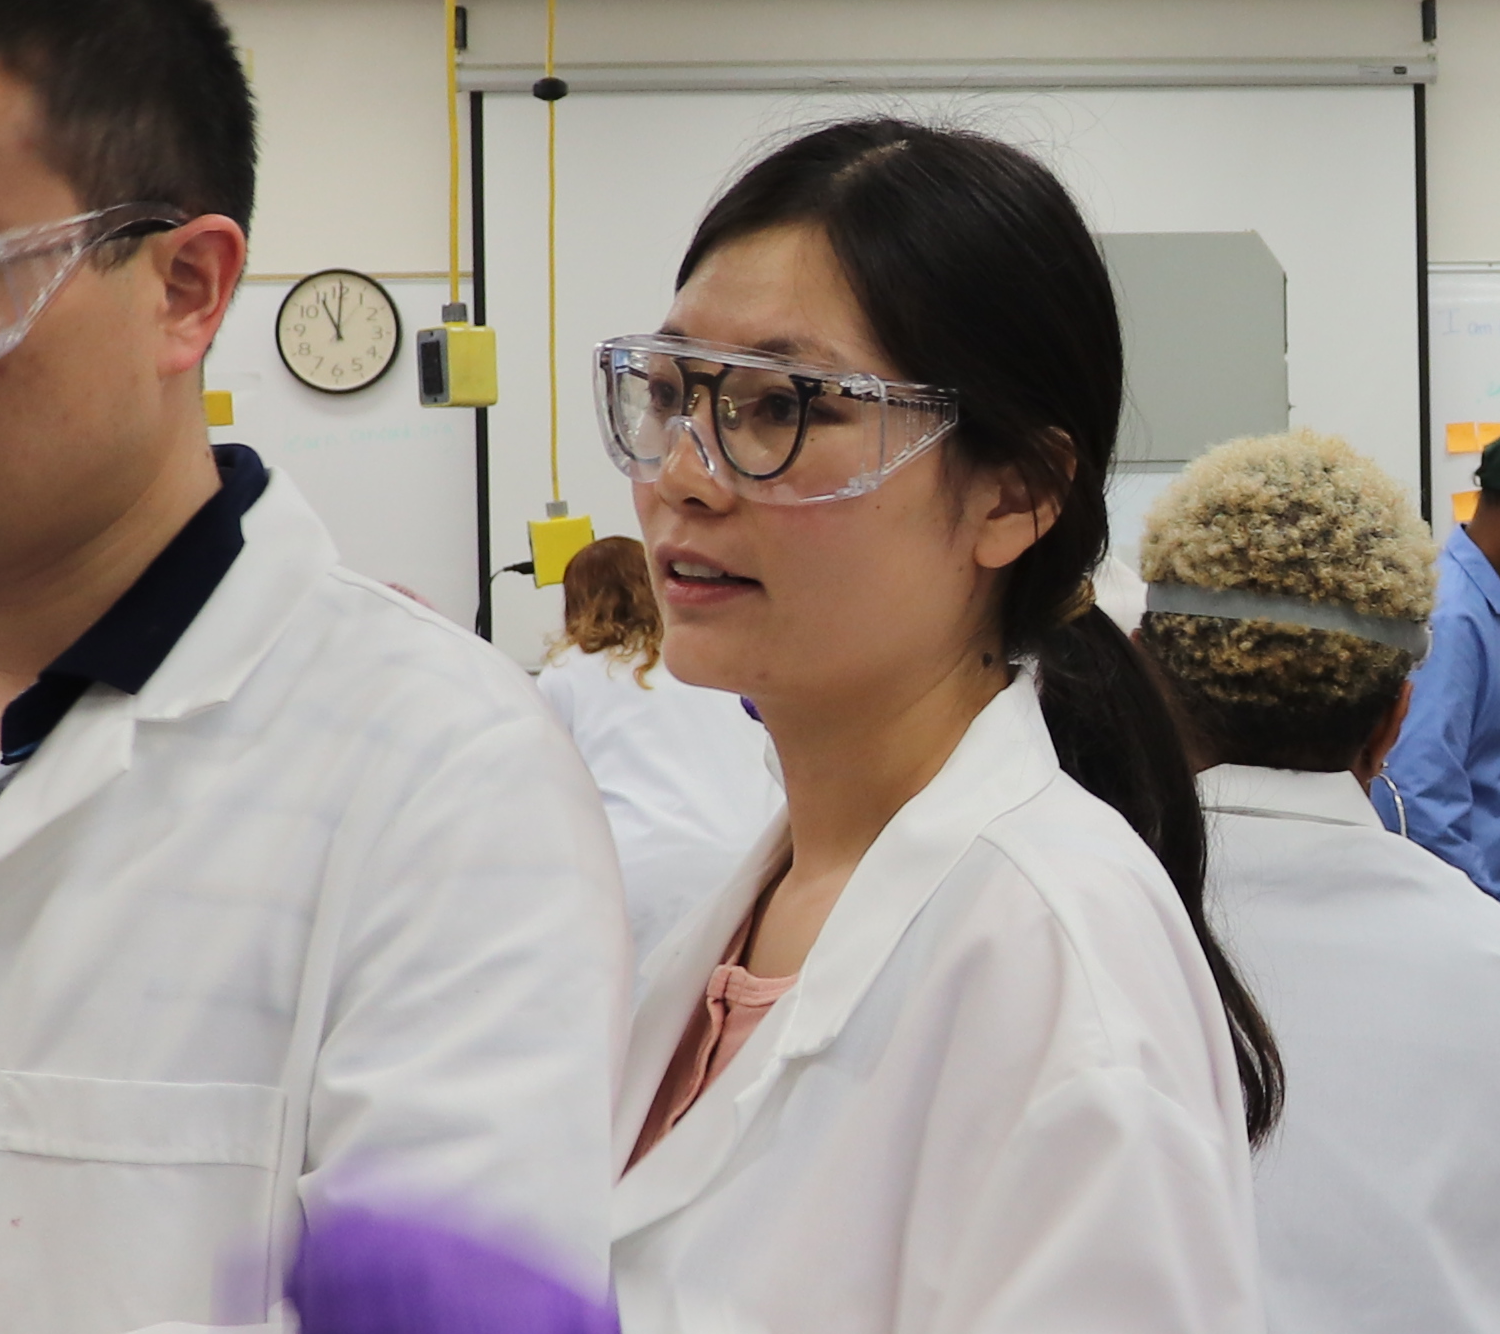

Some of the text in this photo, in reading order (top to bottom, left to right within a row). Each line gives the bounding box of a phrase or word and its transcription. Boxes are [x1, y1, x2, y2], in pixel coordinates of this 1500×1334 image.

[358, 292, 363, 306] 1
[300, 305, 319, 319] 10
[366, 307, 378, 321] 2
[294, 324, 306, 337] 9
[371, 327, 383, 340] 3
[298, 342, 311, 356] 8
[366, 346, 377, 359] 4
[314, 355, 324, 370] 7
[351, 357, 363, 372] 5
[331, 364, 344, 377] 6
